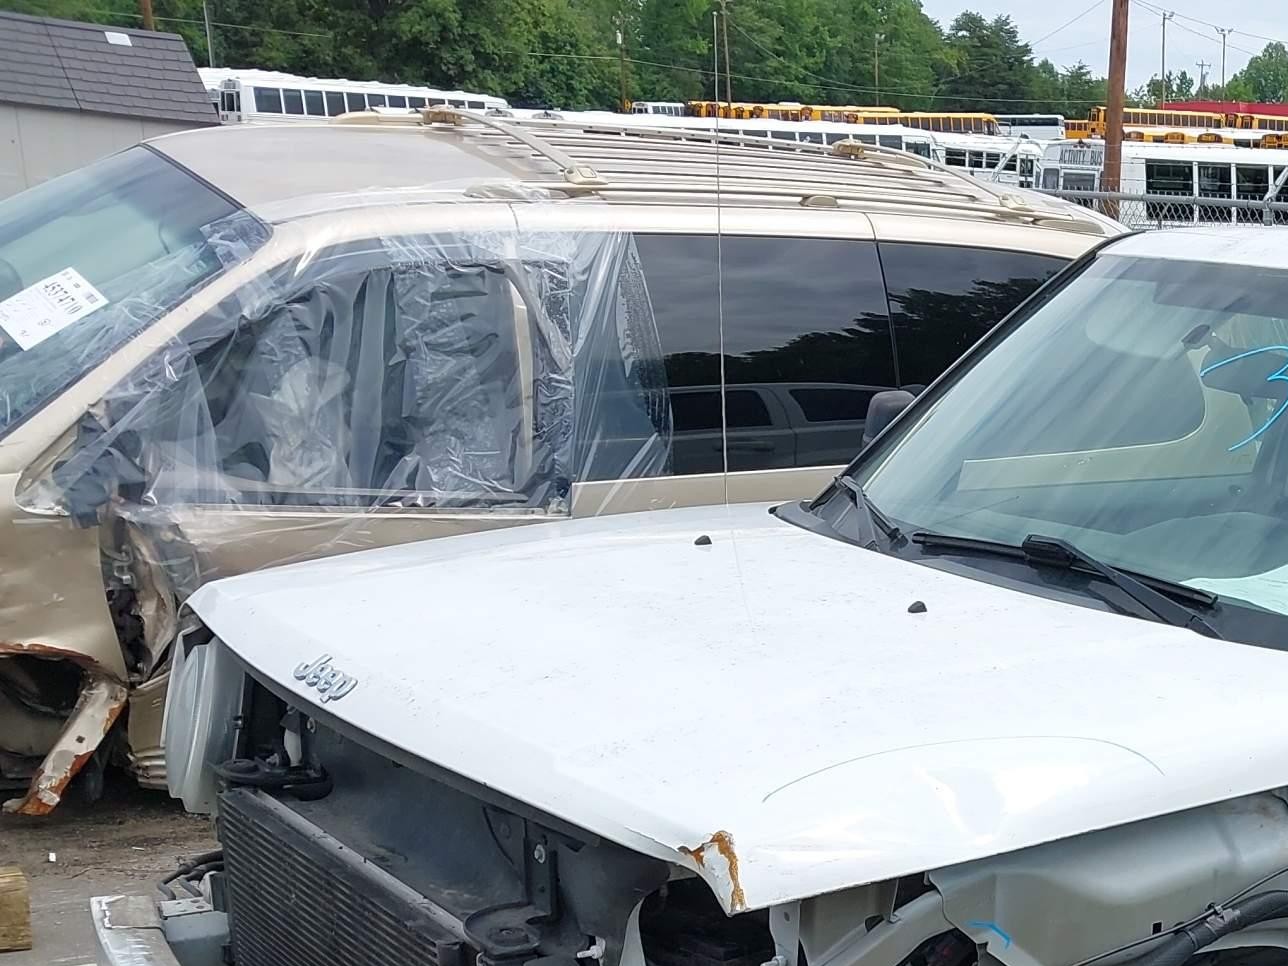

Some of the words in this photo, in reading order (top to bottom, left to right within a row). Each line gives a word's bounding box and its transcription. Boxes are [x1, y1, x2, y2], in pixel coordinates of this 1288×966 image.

[1059, 149, 1087, 164] ACTIVITY
[1089, 150, 1103, 166] BUS
[293, 653, 359, 704] Jeep
